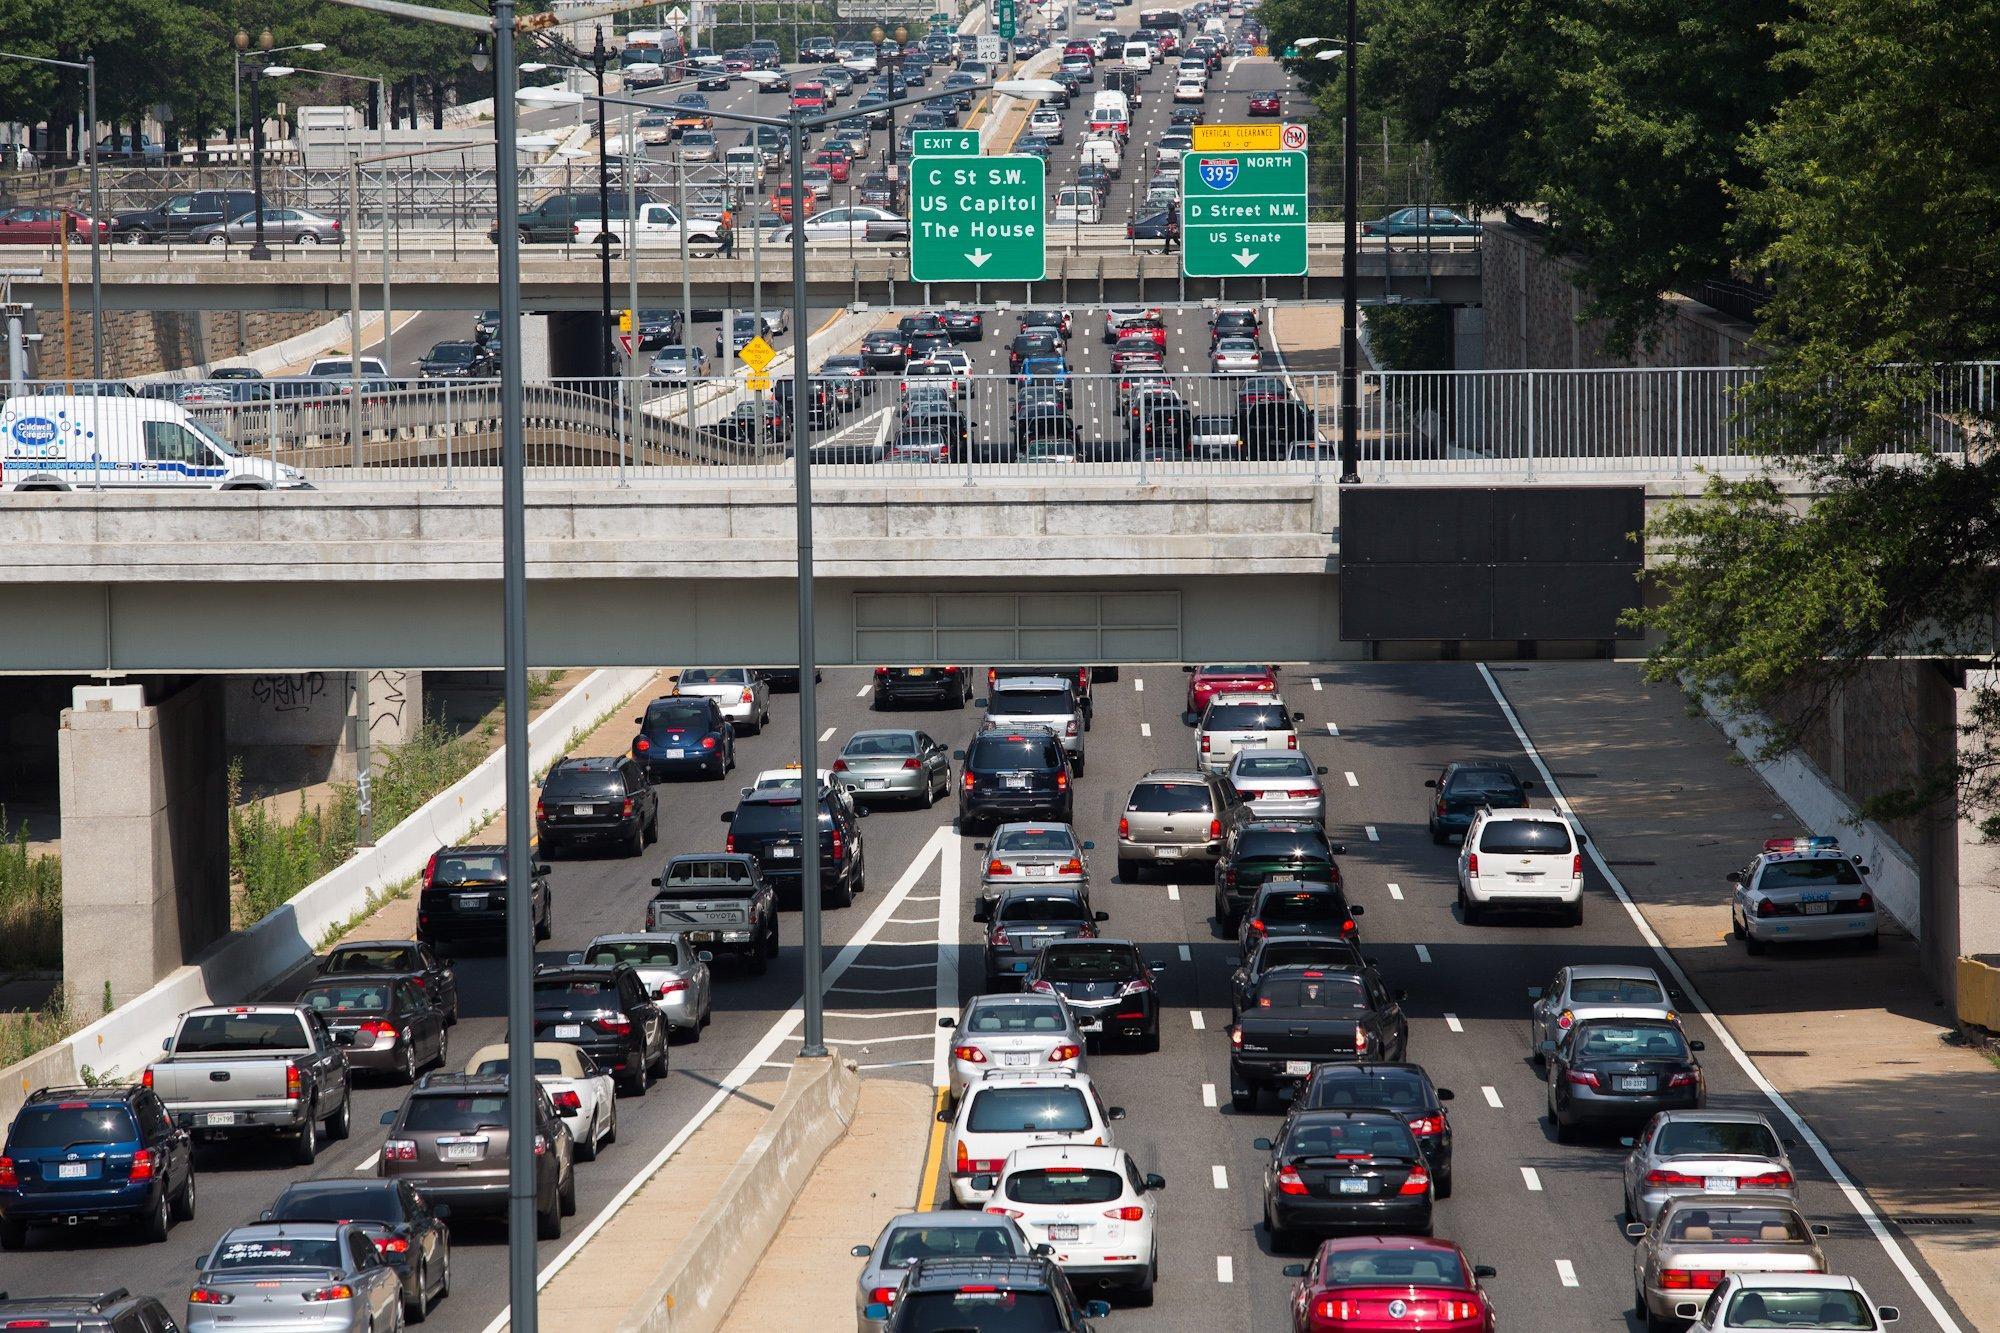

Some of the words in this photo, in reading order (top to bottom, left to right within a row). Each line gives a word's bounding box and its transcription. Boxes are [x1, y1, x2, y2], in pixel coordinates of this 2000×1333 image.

[981, 51, 997, 59] 40
[1201, 130, 1231, 138] VERTICAL
[1236, 128, 1273, 137] CLEARANCE
[923, 138, 952, 149] EXIT
[960, 137, 970, 149] 6
[1246, 157, 1291, 168] NORTH
[929, 169, 942, 185] C
[954, 169, 977, 185] St
[988, 169, 1026, 185] S.W.
[1206, 167, 1234, 181] 395
[920, 196, 948, 212] US
[959, 195, 1036, 214] Capitol
[1191, 205, 1202, 217] D
[1210, 204, 1261, 217] Street
[1269, 204, 1299, 216] N.W.
[921, 222, 959, 238] The
[971, 221, 1036, 237] House
[1209, 232, 1228, 243] US
[1234, 232, 1281, 243] Senate
[18, 423, 52, 431] Caldwell
[1801, 893, 1829, 901] POLICE
